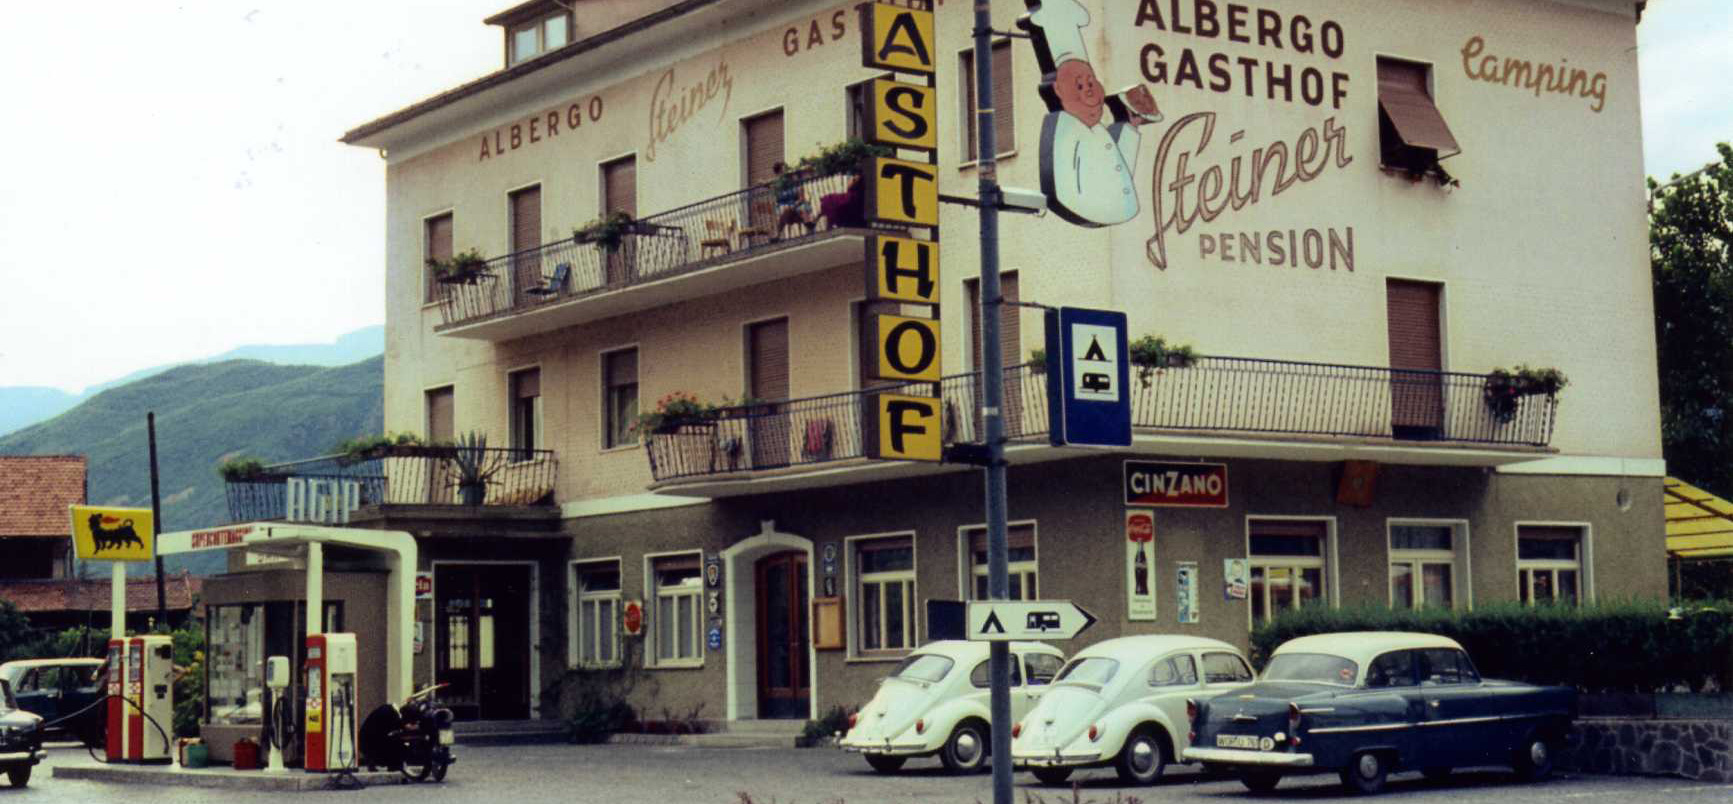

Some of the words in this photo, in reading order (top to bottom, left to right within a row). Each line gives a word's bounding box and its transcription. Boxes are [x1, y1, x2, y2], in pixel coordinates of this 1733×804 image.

[1134, 0, 1344, 59] ALBERGO
[1139, 43, 1349, 109] GASTHOF
[1460, 35, 1607, 113] Camping
[479, 96, 604, 162] ALBERGO
[646, 62, 733, 162] Steiner
[1146, 111, 1353, 271] Steiner
[1199, 227, 1355, 273] PENSION
[1130, 471, 1222, 497] CINZANO
